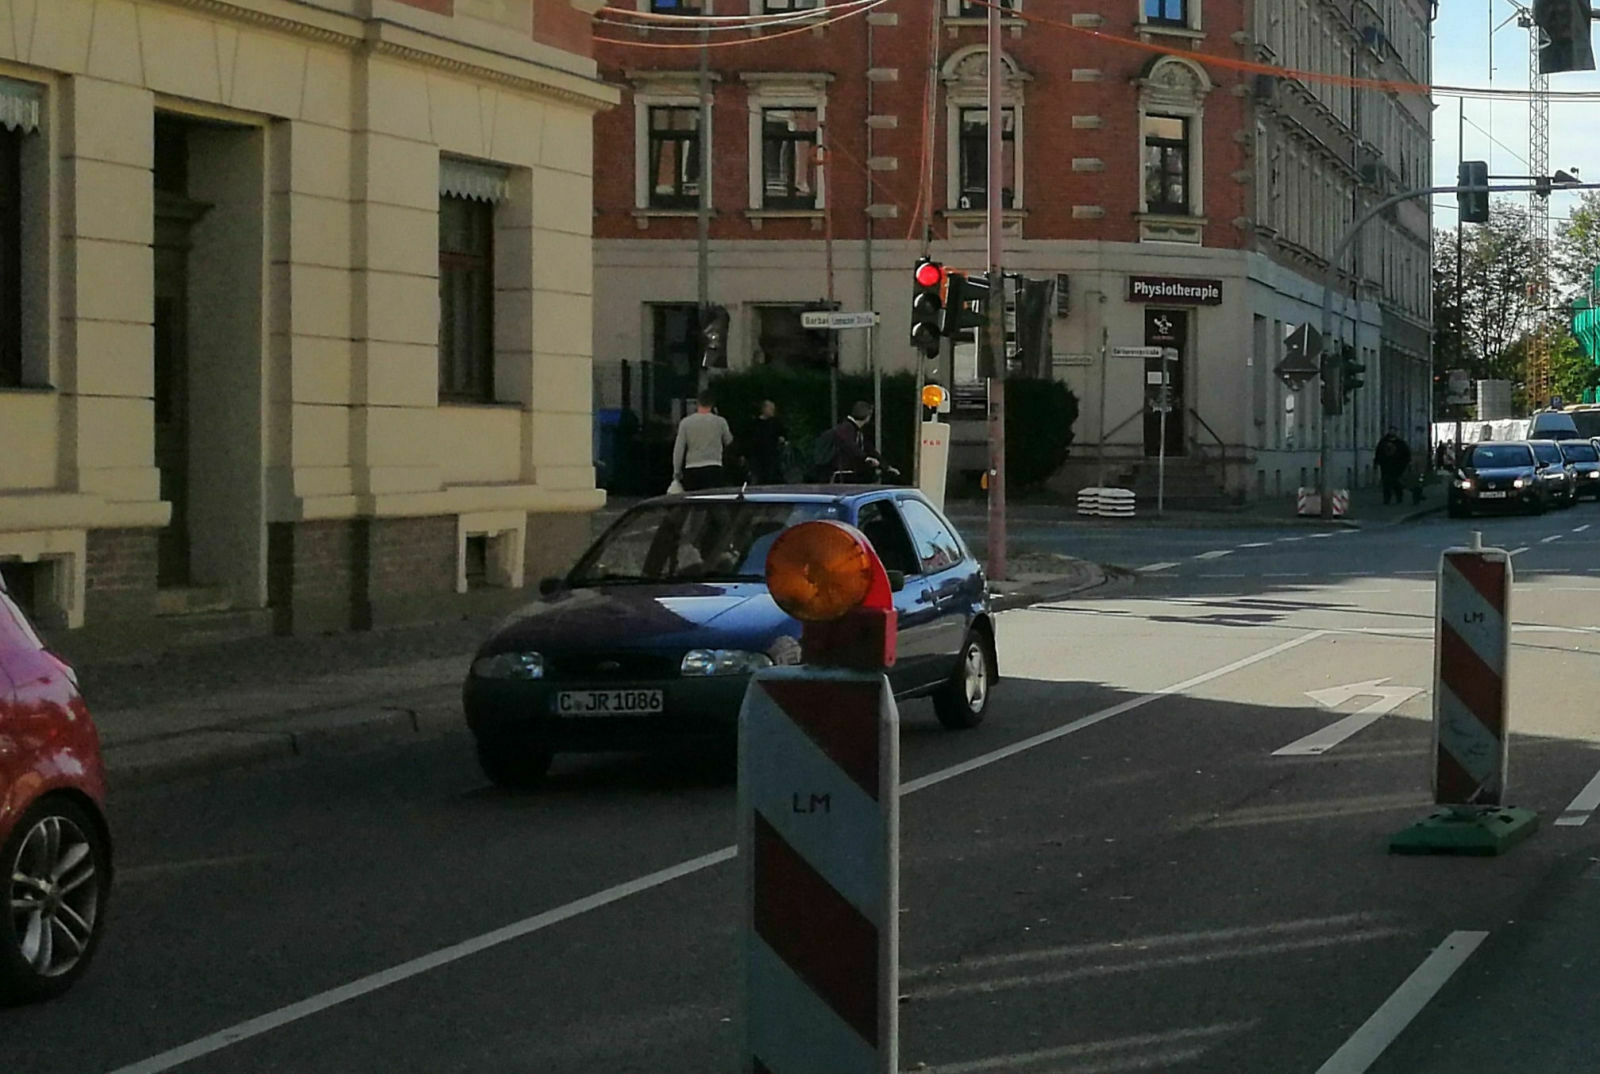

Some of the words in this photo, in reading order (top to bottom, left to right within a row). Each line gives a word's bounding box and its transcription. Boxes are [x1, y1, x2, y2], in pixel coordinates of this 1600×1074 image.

[1134, 281, 1219, 300] Physiotherapie
[1463, 611, 1484, 625] LM
[792, 791, 832, 814] LM
